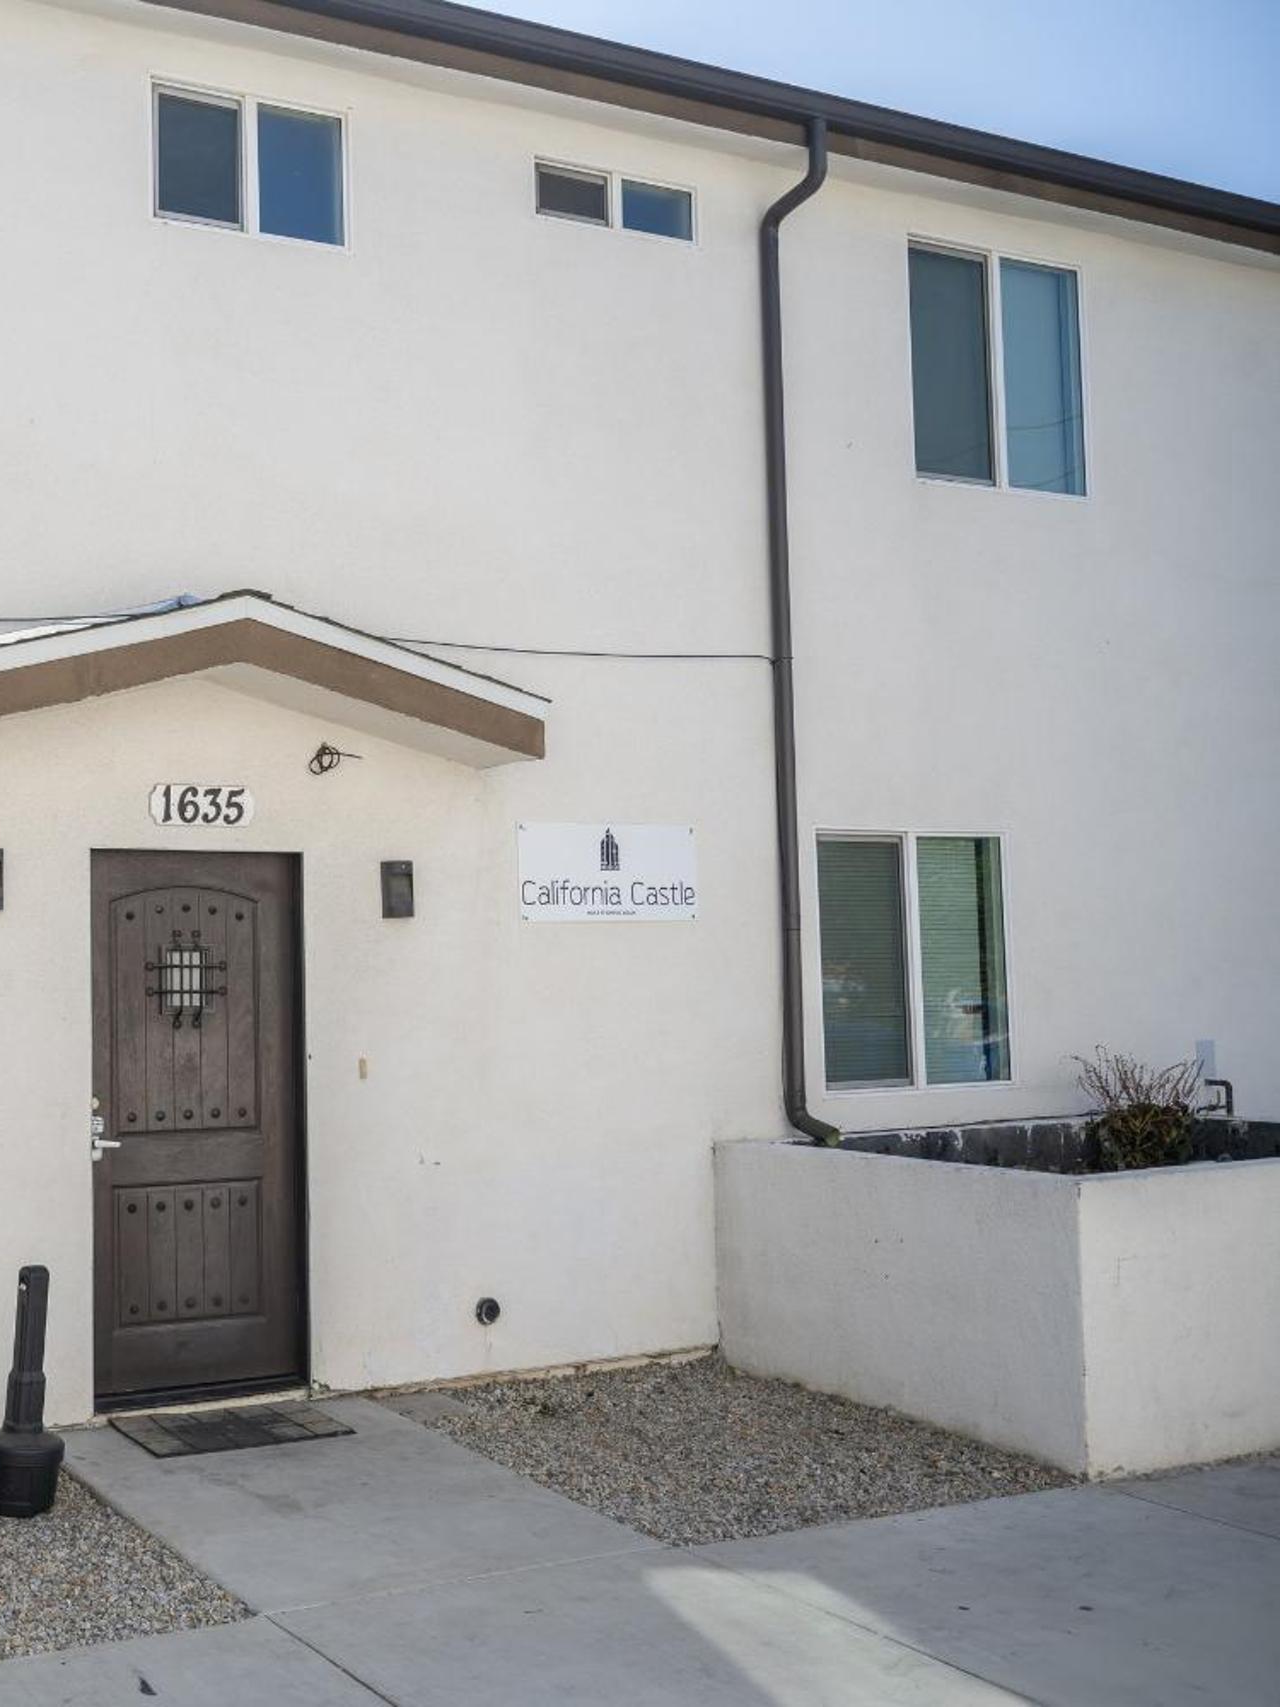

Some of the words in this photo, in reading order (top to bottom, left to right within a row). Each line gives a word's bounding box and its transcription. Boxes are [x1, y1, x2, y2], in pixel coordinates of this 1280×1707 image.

[162, 785, 245, 825] 1635
[521, 880, 621, 906] California
[630, 881, 696, 906] Castle
